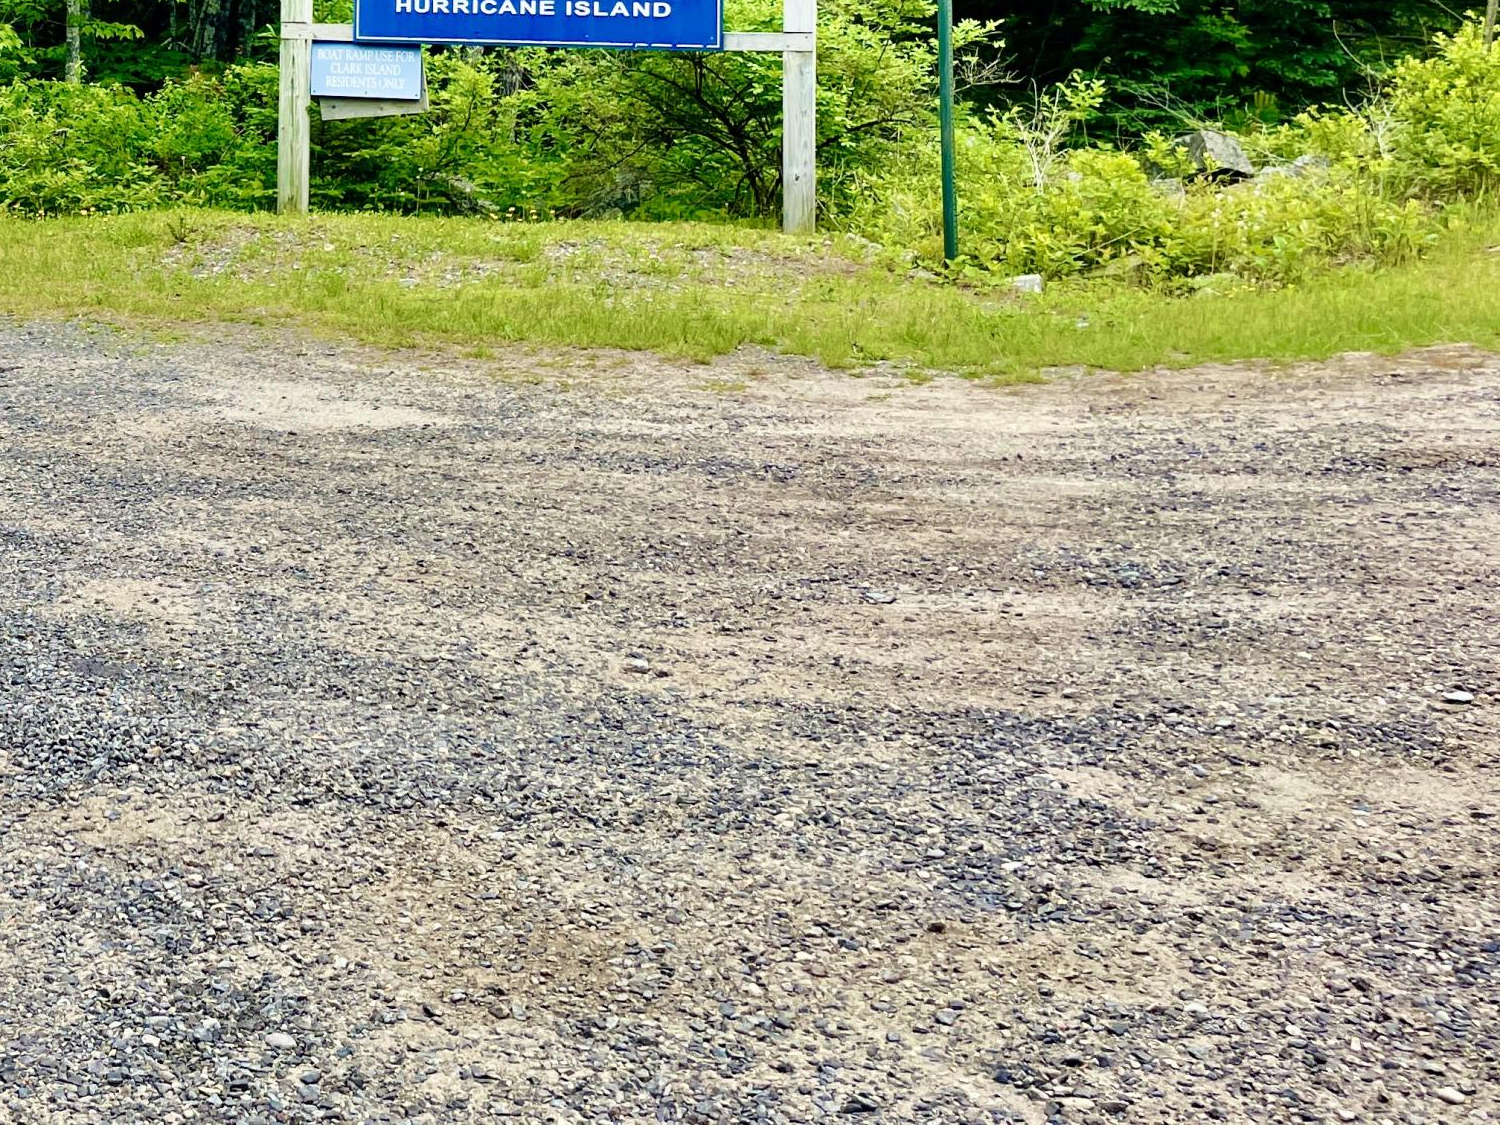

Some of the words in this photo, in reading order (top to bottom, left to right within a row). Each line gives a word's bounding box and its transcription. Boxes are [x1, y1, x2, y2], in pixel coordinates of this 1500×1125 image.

[565, 0, 672, 18] ISLAND
[317, 49, 343, 60] BOAT
[345, 50, 373, 61] RAMP
[375, 51, 394, 62] USE
[395, 51, 415, 62] FOR
[331, 63, 362, 74] CLARK
[365, 64, 400, 75] ISLAND
[326, 76, 376, 88] RESIDENTS
[378, 77, 405, 89] ONLY
